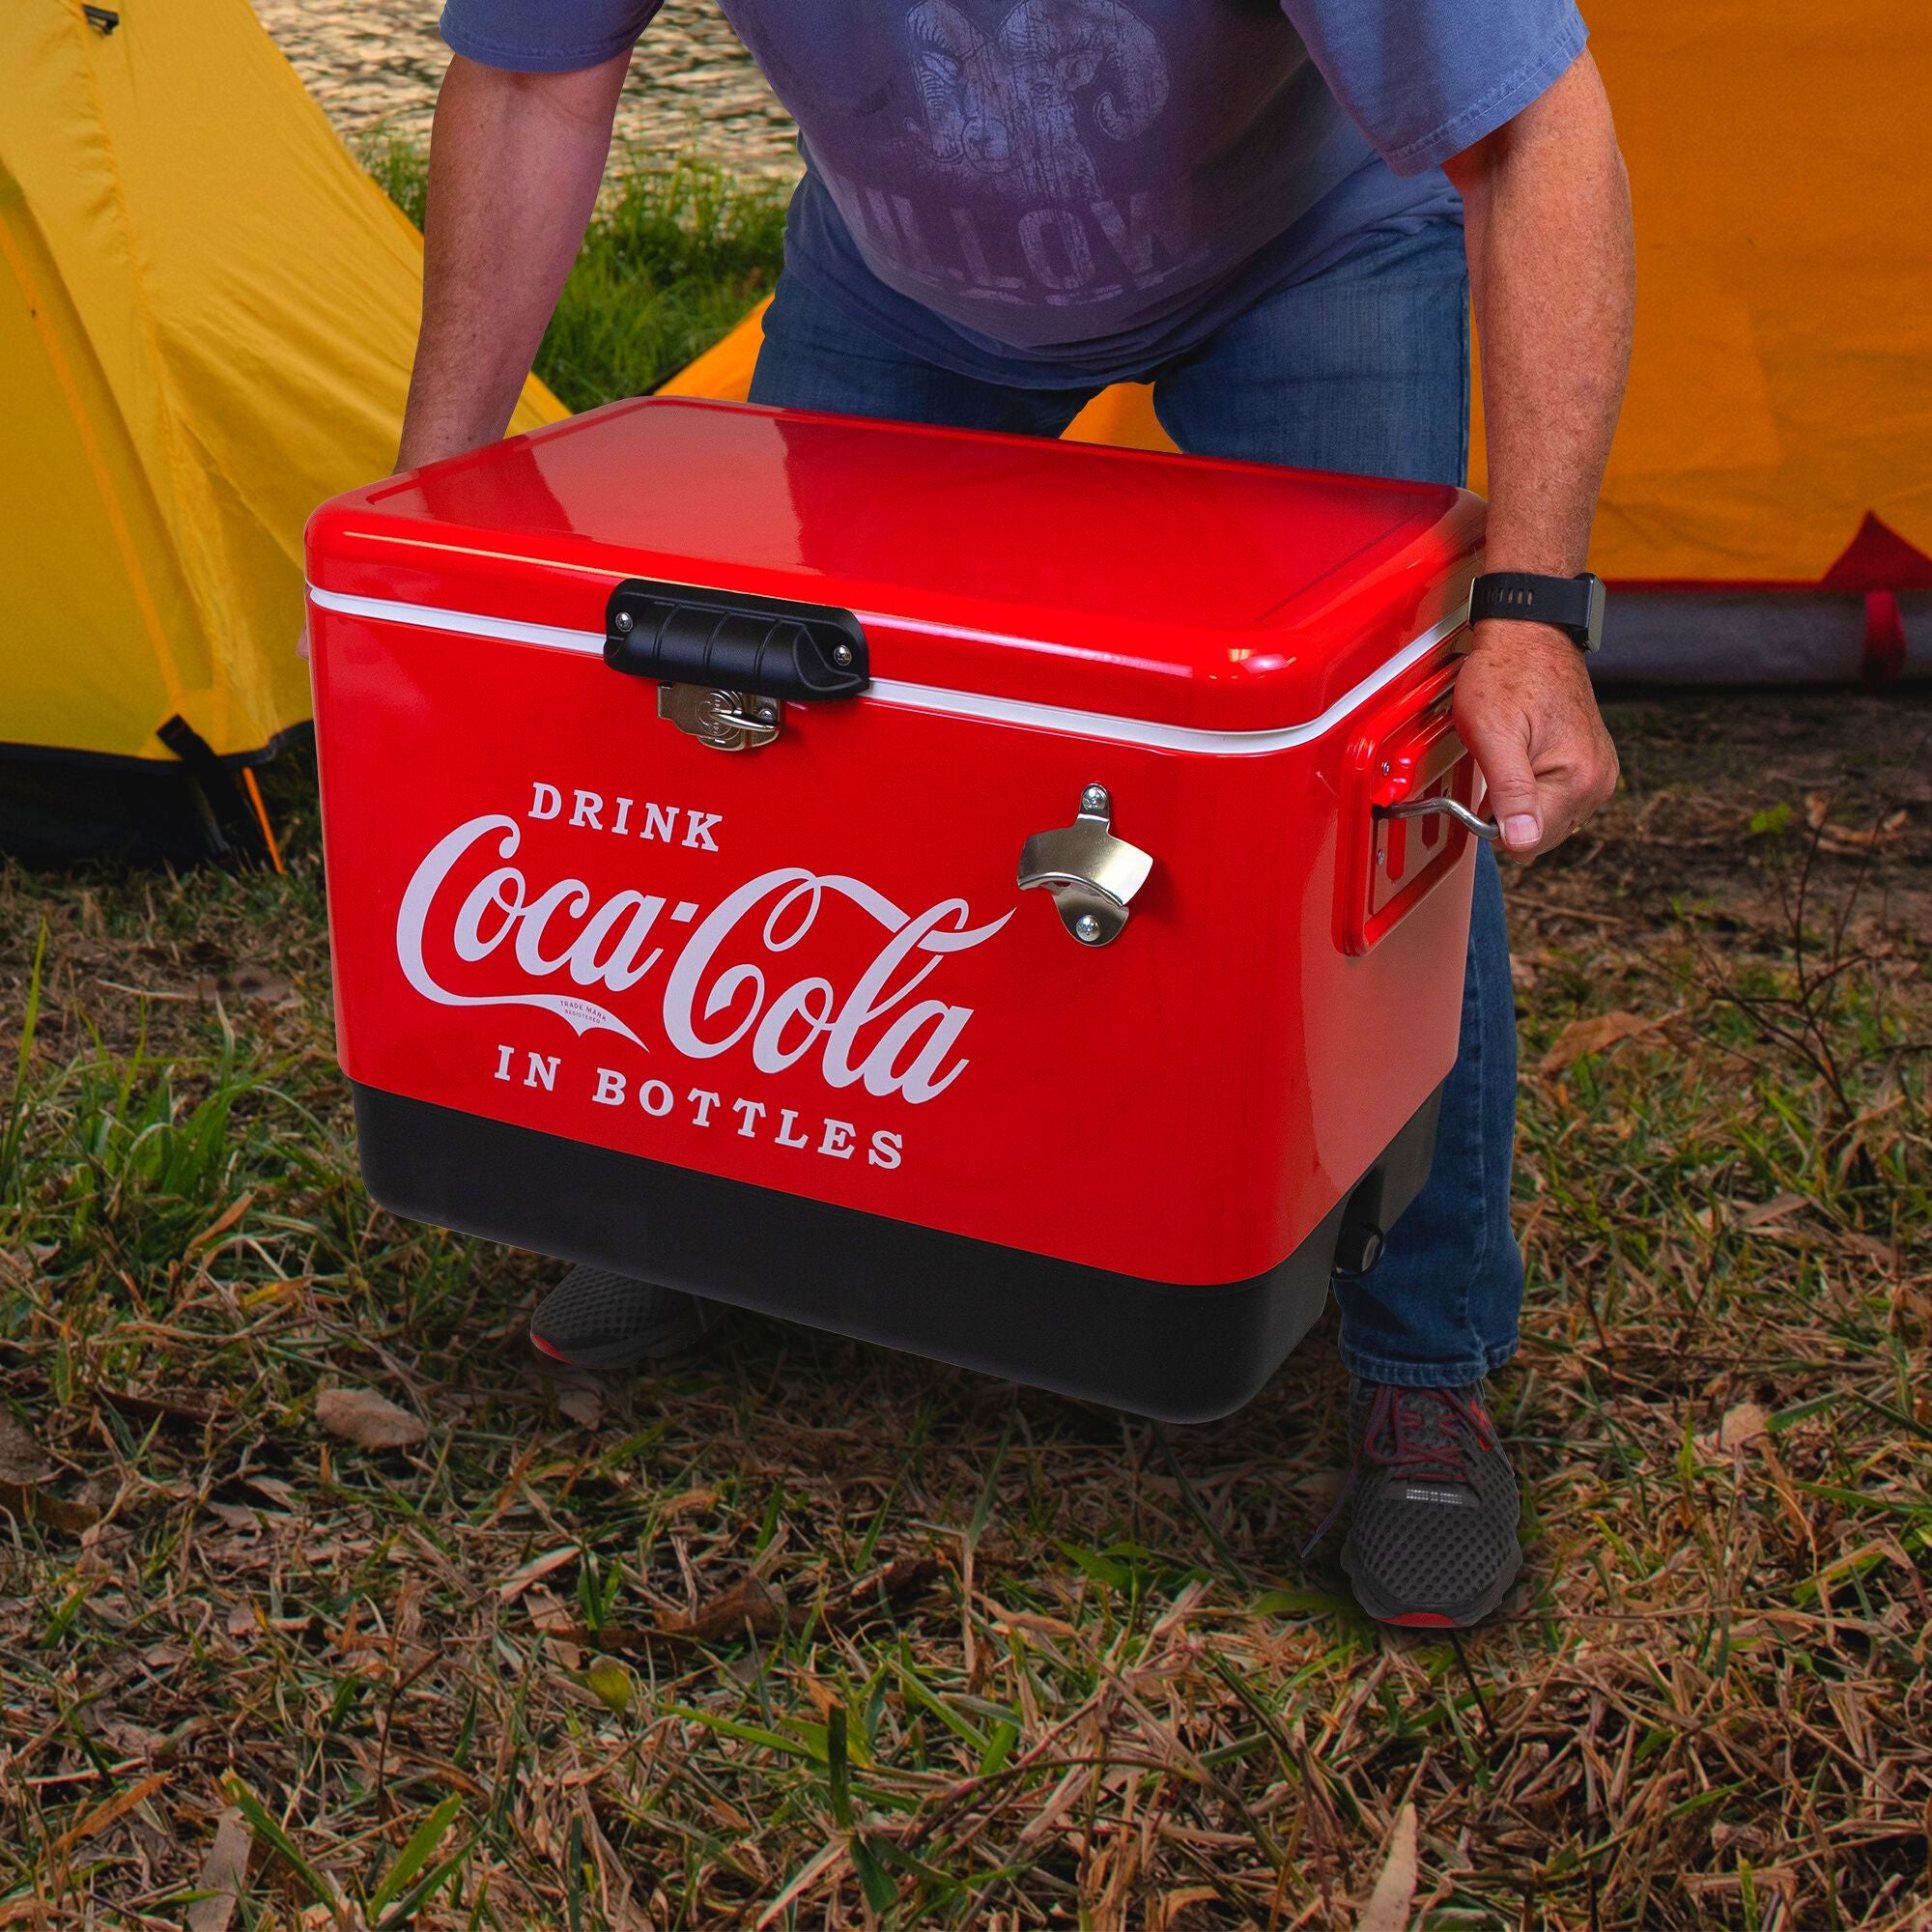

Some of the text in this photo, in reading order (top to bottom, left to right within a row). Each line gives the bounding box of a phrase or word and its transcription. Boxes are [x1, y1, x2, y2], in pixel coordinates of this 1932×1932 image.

[527, 781, 723, 852] DRINK
[396, 813, 1017, 1104] Coca-Cola
[560, 1001, 607, 1021] TRADE MARK
[564, 1009, 601, 1023] REGISTERED
[494, 1044, 903, 1170] IN BOTTLES
